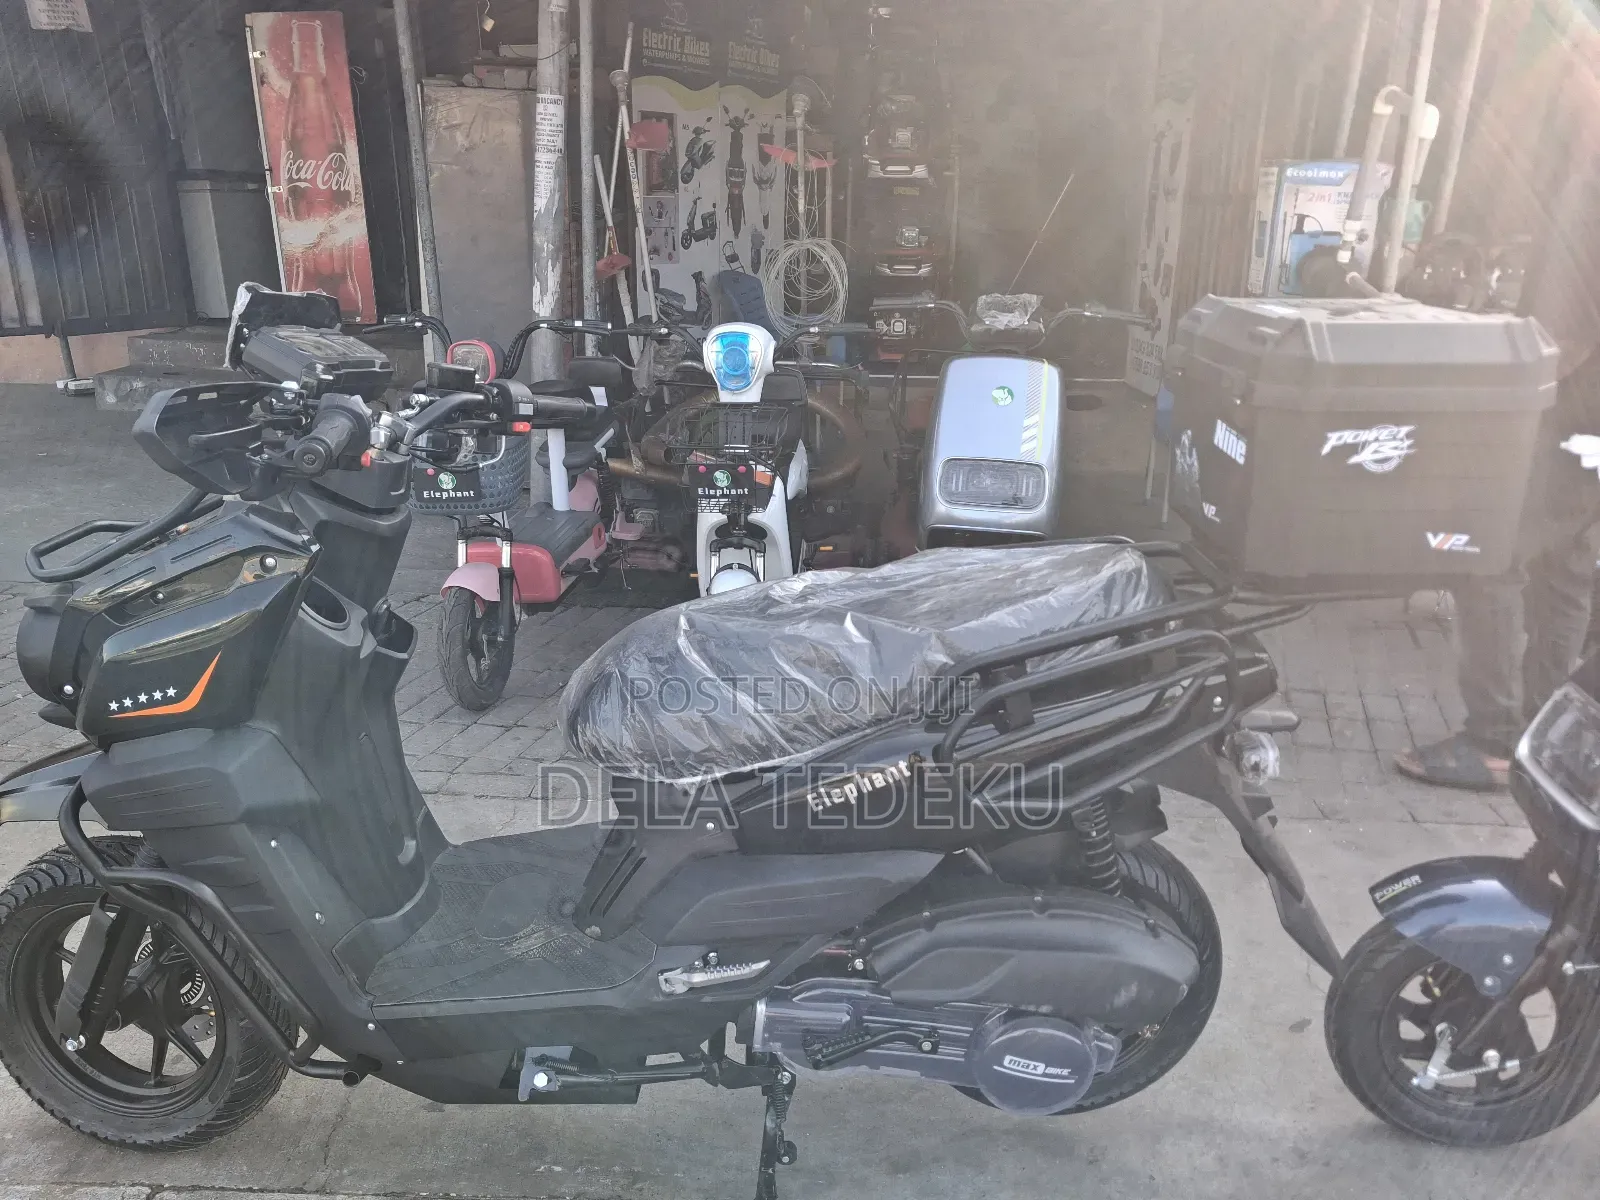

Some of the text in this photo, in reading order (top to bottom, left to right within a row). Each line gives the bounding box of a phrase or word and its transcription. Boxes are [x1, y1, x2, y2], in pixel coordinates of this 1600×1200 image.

[642, 27, 682, 53] Electric
[684, 35, 710, 58] Bikes
[284, 150, 355, 192] Coca-Cola
[1213, 419, 1247, 467] Nine
[423, 490, 475, 500] Elephant
[697, 487, 749, 498] Elephant
[806, 760, 912, 812] Elephant
[1374, 874, 1423, 901] POWER
[1007, 1057, 1072, 1076] max BIKE
